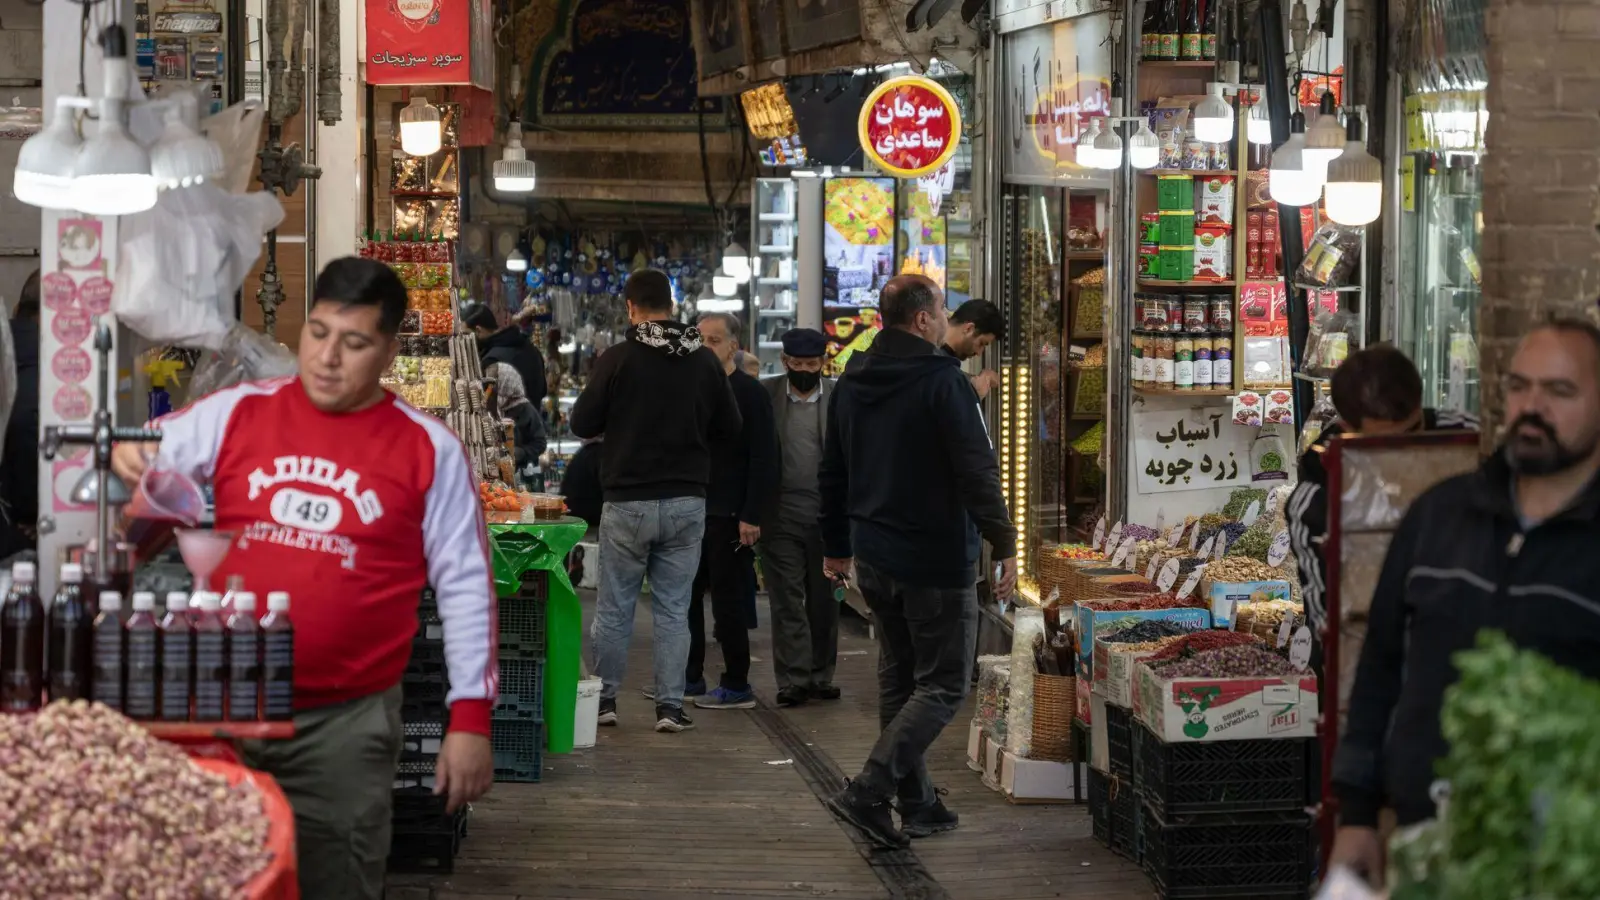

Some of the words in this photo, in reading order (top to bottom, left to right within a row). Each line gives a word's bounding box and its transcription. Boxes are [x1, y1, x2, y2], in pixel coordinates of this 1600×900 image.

[155, 15, 220, 33] Energizer
[371, 51, 428, 67] سبزیجات
[431, 52, 463, 67] سوپر
[875, 95, 944, 125] سوهان
[875, 127, 944, 154] ساعدی
[1155, 413, 1223, 449] آسیاب
[1145, 456, 1194, 485] چوبه
[1199, 451, 1238, 481] زرد
[247, 455, 384, 525] ADIDAS
[237, 520, 358, 569] ATHLETICS
[1270, 711, 1299, 729] Tiar
